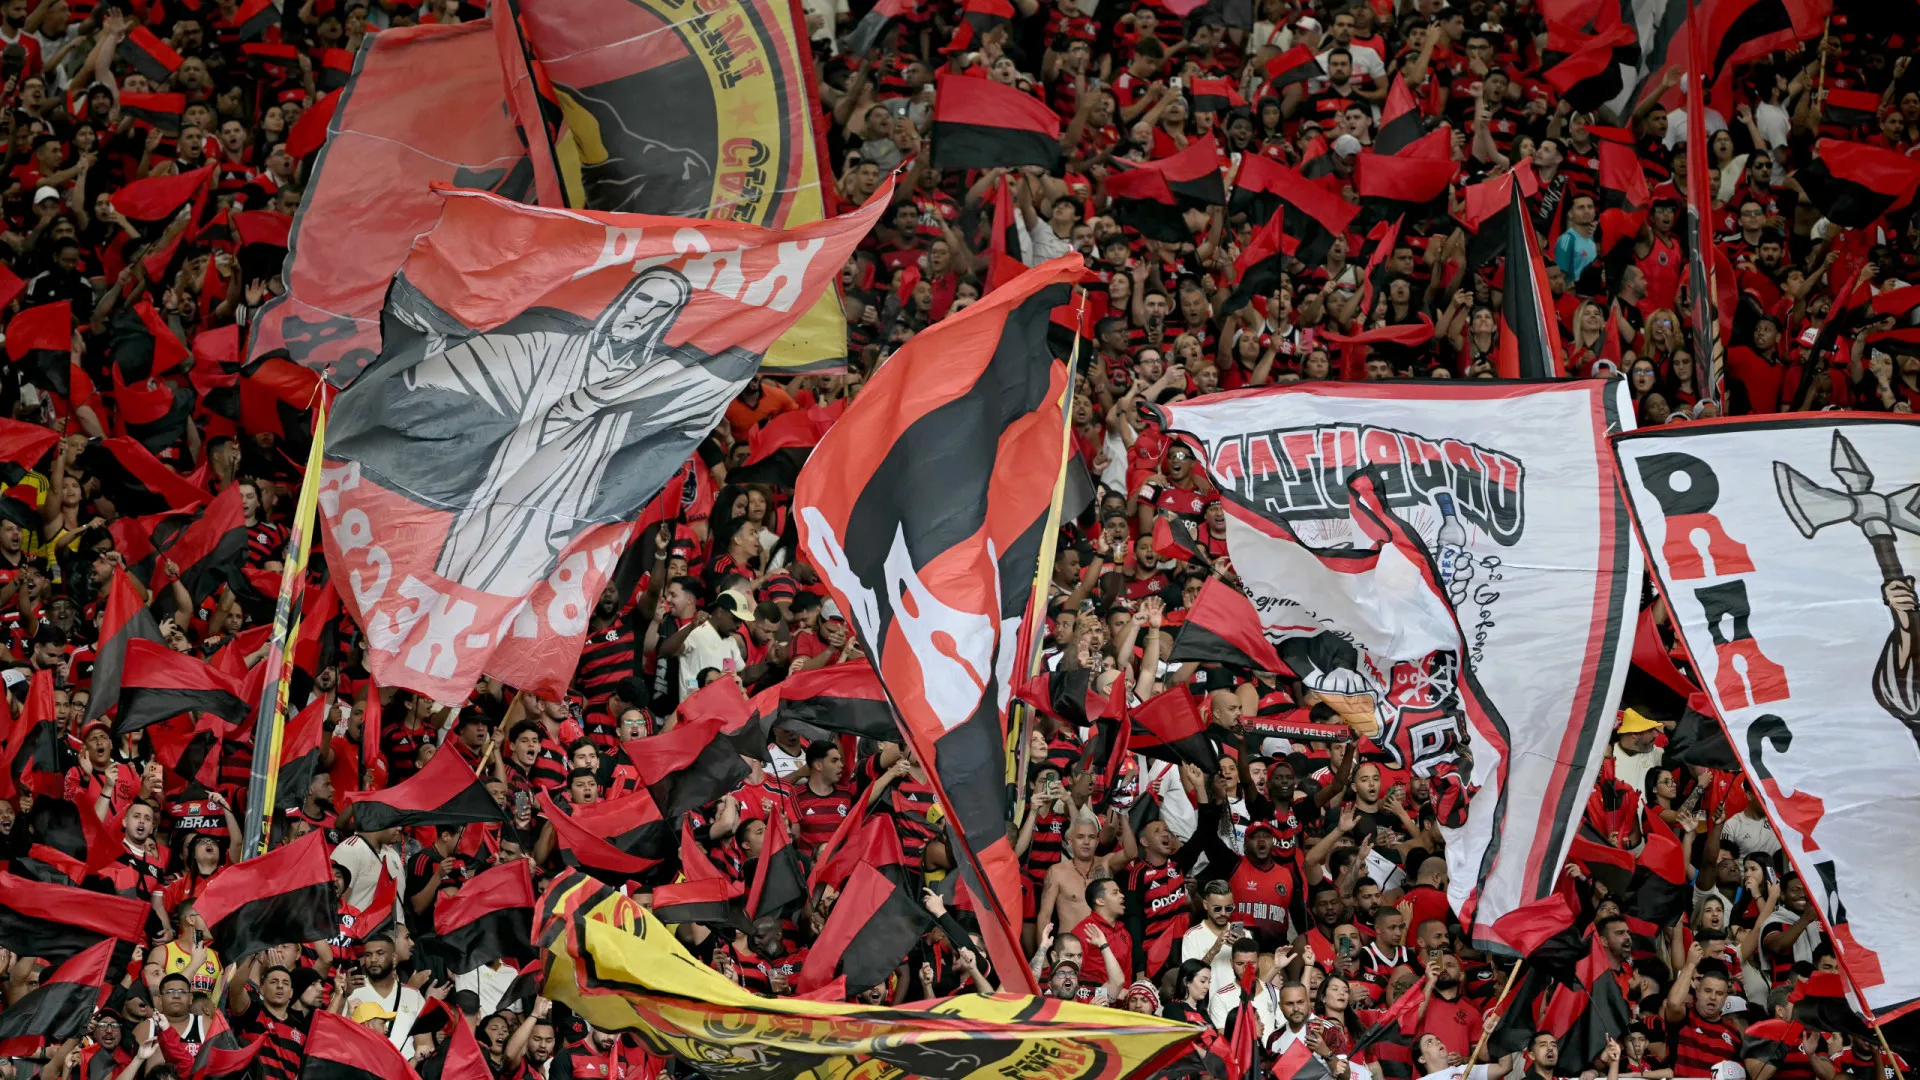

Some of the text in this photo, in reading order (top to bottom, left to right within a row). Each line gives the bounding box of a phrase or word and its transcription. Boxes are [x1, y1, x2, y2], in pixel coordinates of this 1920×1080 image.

[1255, 722, 1336, 738] PRA CIMA DELES!
